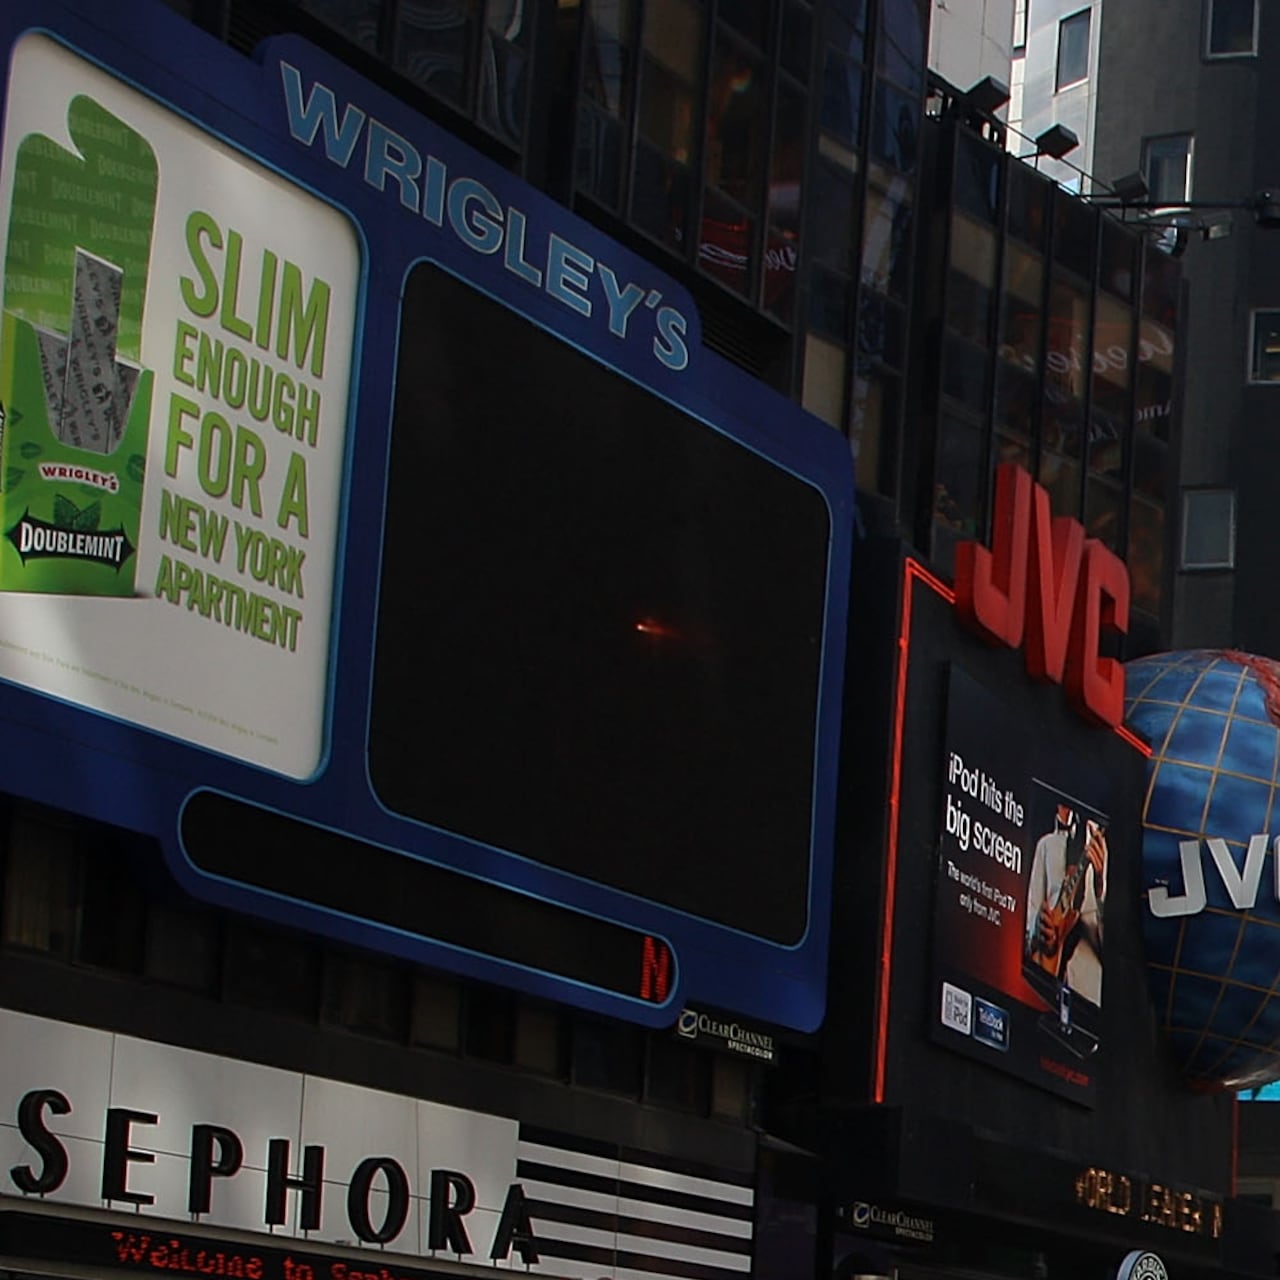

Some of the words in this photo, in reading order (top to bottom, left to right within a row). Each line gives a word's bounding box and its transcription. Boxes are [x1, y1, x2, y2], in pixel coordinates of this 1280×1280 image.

[279, 60, 690, 371] WRIGLEY'S
[180, 210, 332, 380] SLIM
[173, 318, 321, 448] ENOUGH
[41, 465, 118, 491] WRIGLEY'S
[164, 392, 266, 518] FOR
[276, 450, 310, 539] A
[20, 521, 125, 562] DOUBLEMINT
[158, 488, 229, 563] NEW
[234, 520, 306, 599] YORK
[154, 554, 303, 653] APARTMENT
[954, 462, 1130, 730] JVC
[946, 794, 971, 851] big
[973, 821, 1022, 875] screen
[948, 752, 980, 798] iPod
[980, 771, 1003, 814] hits
[1004, 791, 1024, 827] the
[641, 936, 669, 1002] N
[10, 1089, 540, 1264] SEPHORA
[112, 1231, 264, 1279] Welcome
